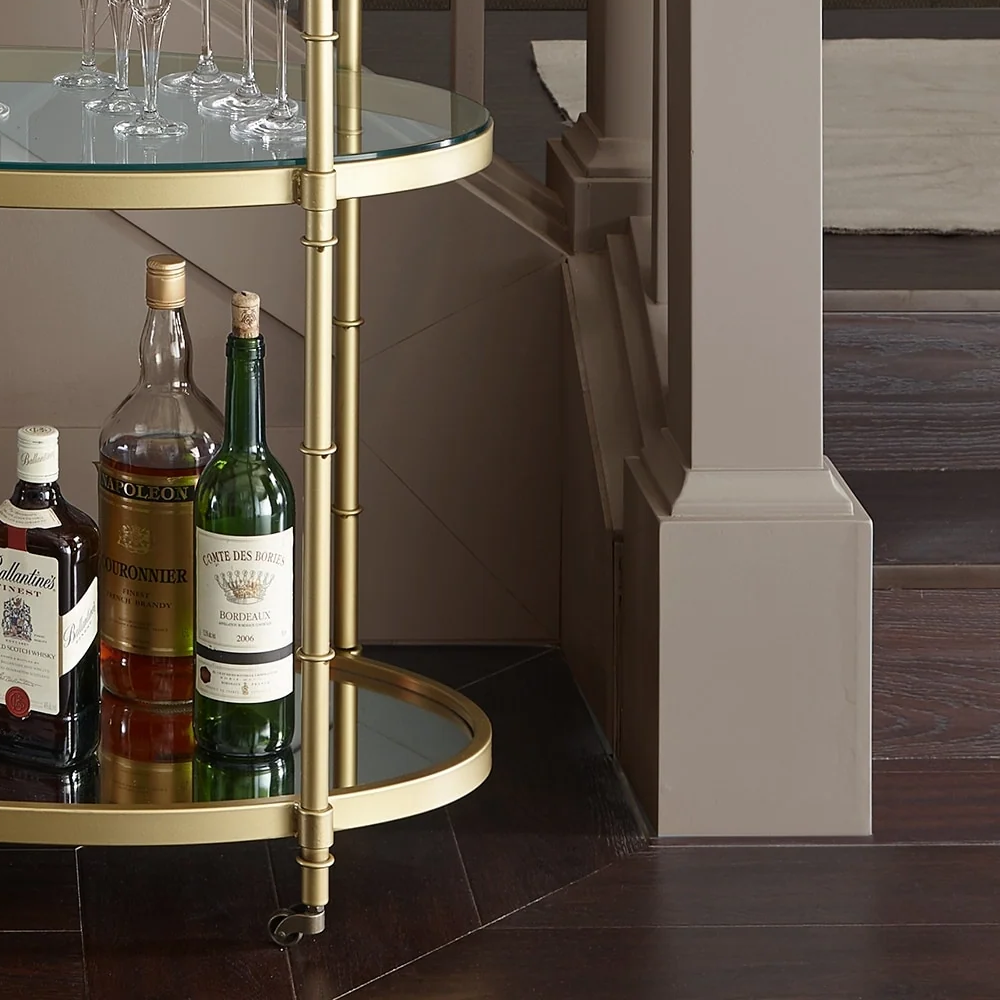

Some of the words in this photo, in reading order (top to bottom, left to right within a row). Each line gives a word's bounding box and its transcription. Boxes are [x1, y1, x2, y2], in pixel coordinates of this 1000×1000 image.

[101, 473, 188, 500] NAPOLEON
[202, 550, 231, 566] COMTE
[233, 550, 252, 561] DES
[255, 551, 285, 566] BORIES
[101, 556, 188, 584] OURONNIER
[122, 588, 150, 598] FINEST
[135, 599, 172, 609] BRANDY
[220, 610, 271, 621] BORDEAUX
[236, 634, 255, 643] 2006
[7, 645, 31, 655] SCOTCH
[31, 650, 56, 660] WHISKY
